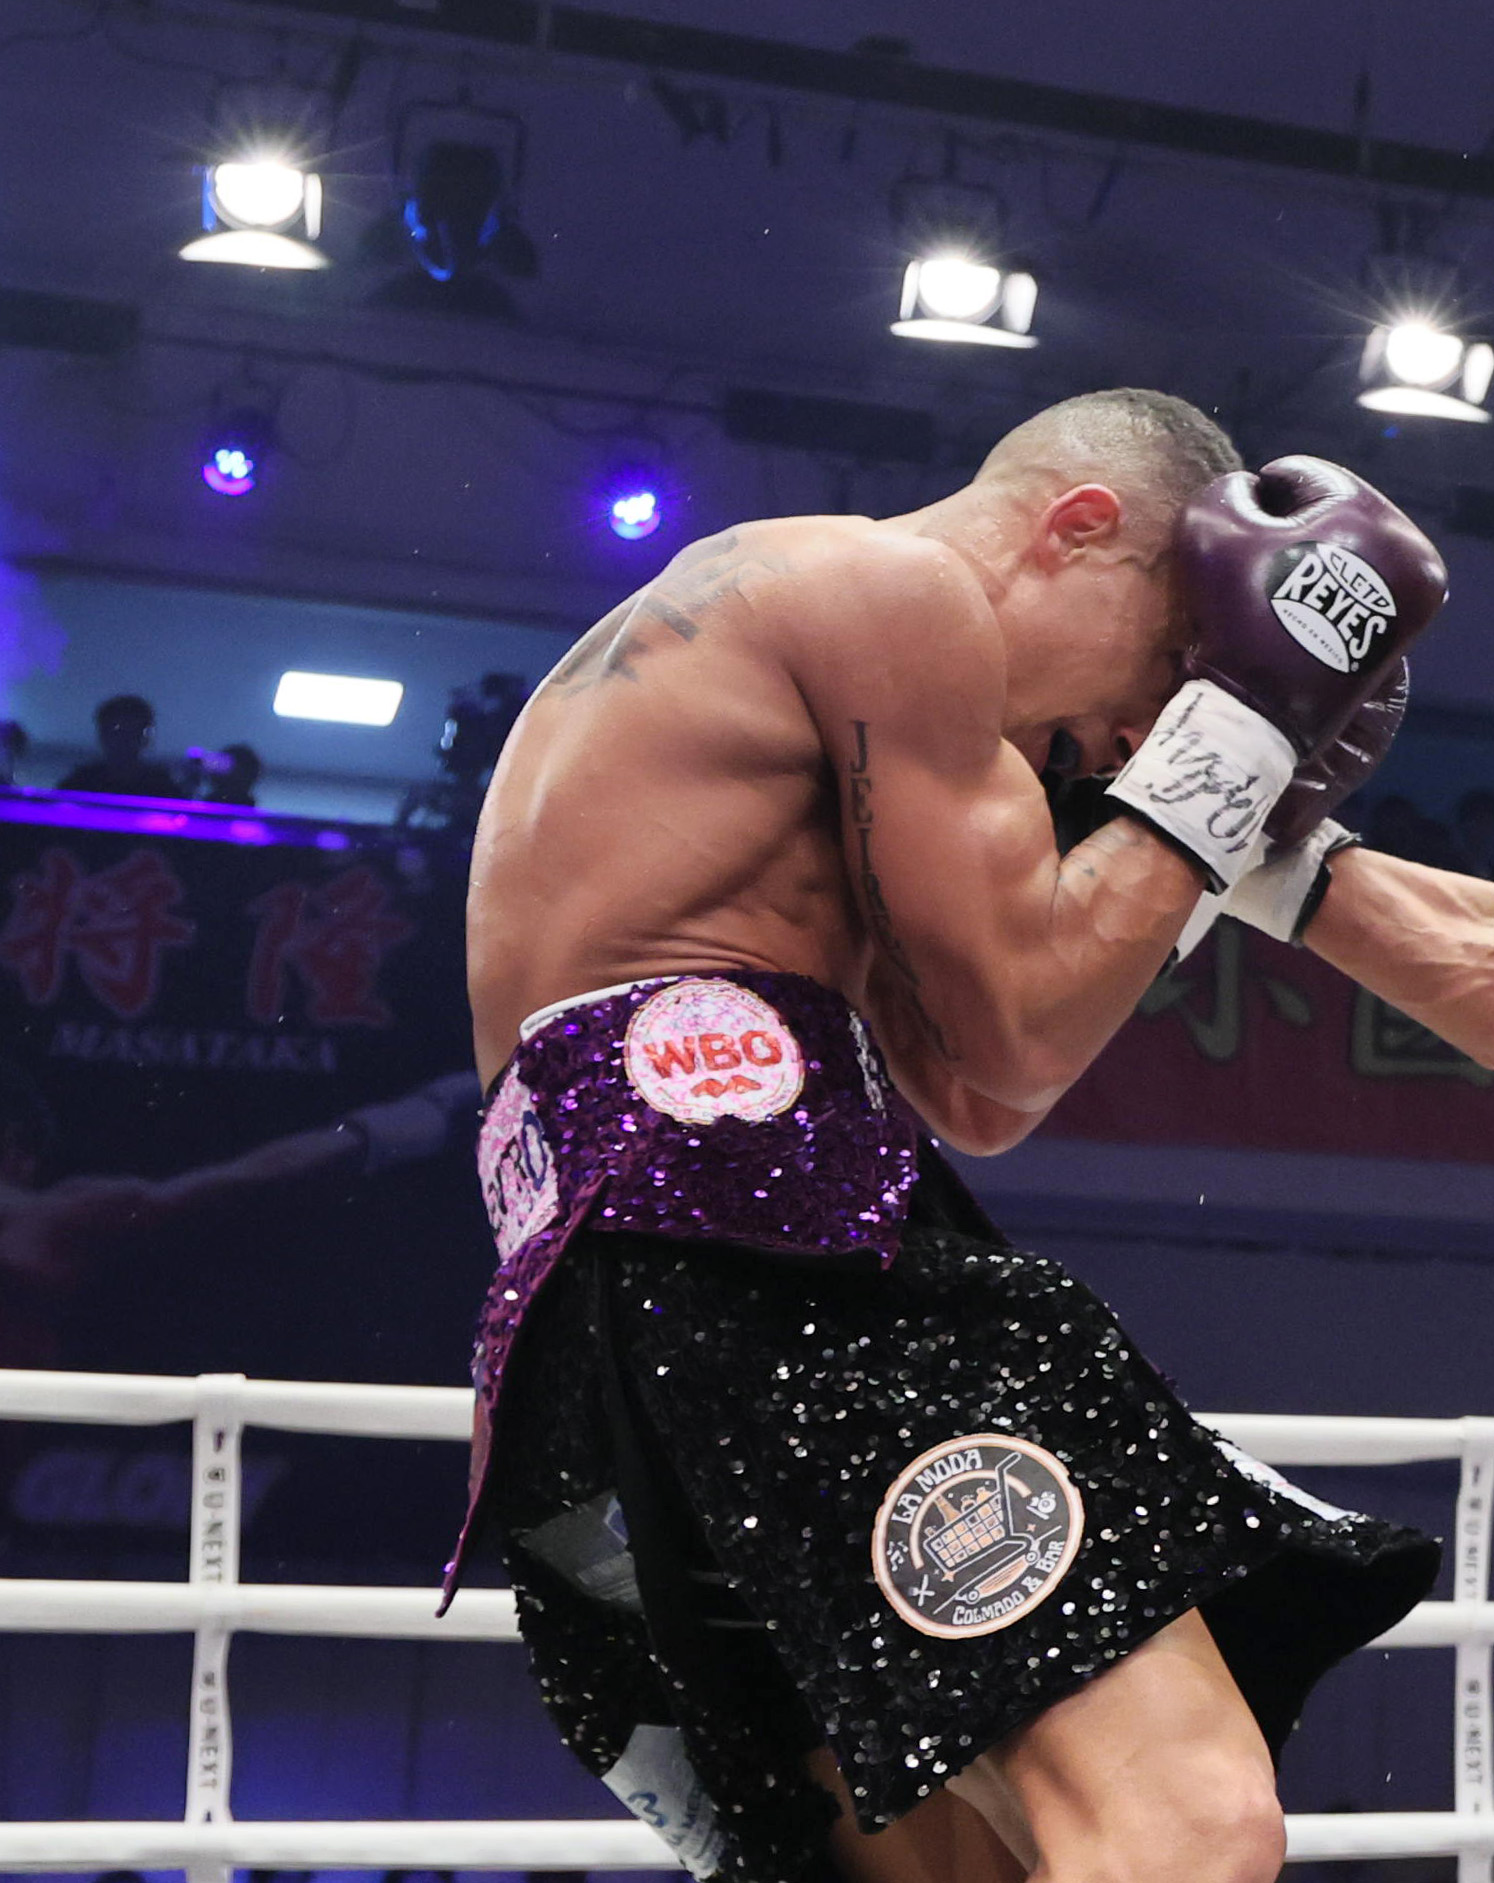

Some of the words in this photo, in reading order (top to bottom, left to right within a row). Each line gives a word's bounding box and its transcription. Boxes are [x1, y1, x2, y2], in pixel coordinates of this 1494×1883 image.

[1272, 552, 1388, 660] REYES
[643, 1030, 782, 1079] WBO
[891, 1492, 923, 1525] LA
[915, 1448, 984, 1493] MODA
[952, 1590, 1025, 1625] COLMADO
[1021, 1575, 1044, 1594] &
[1035, 1540, 1066, 1574] BAR
